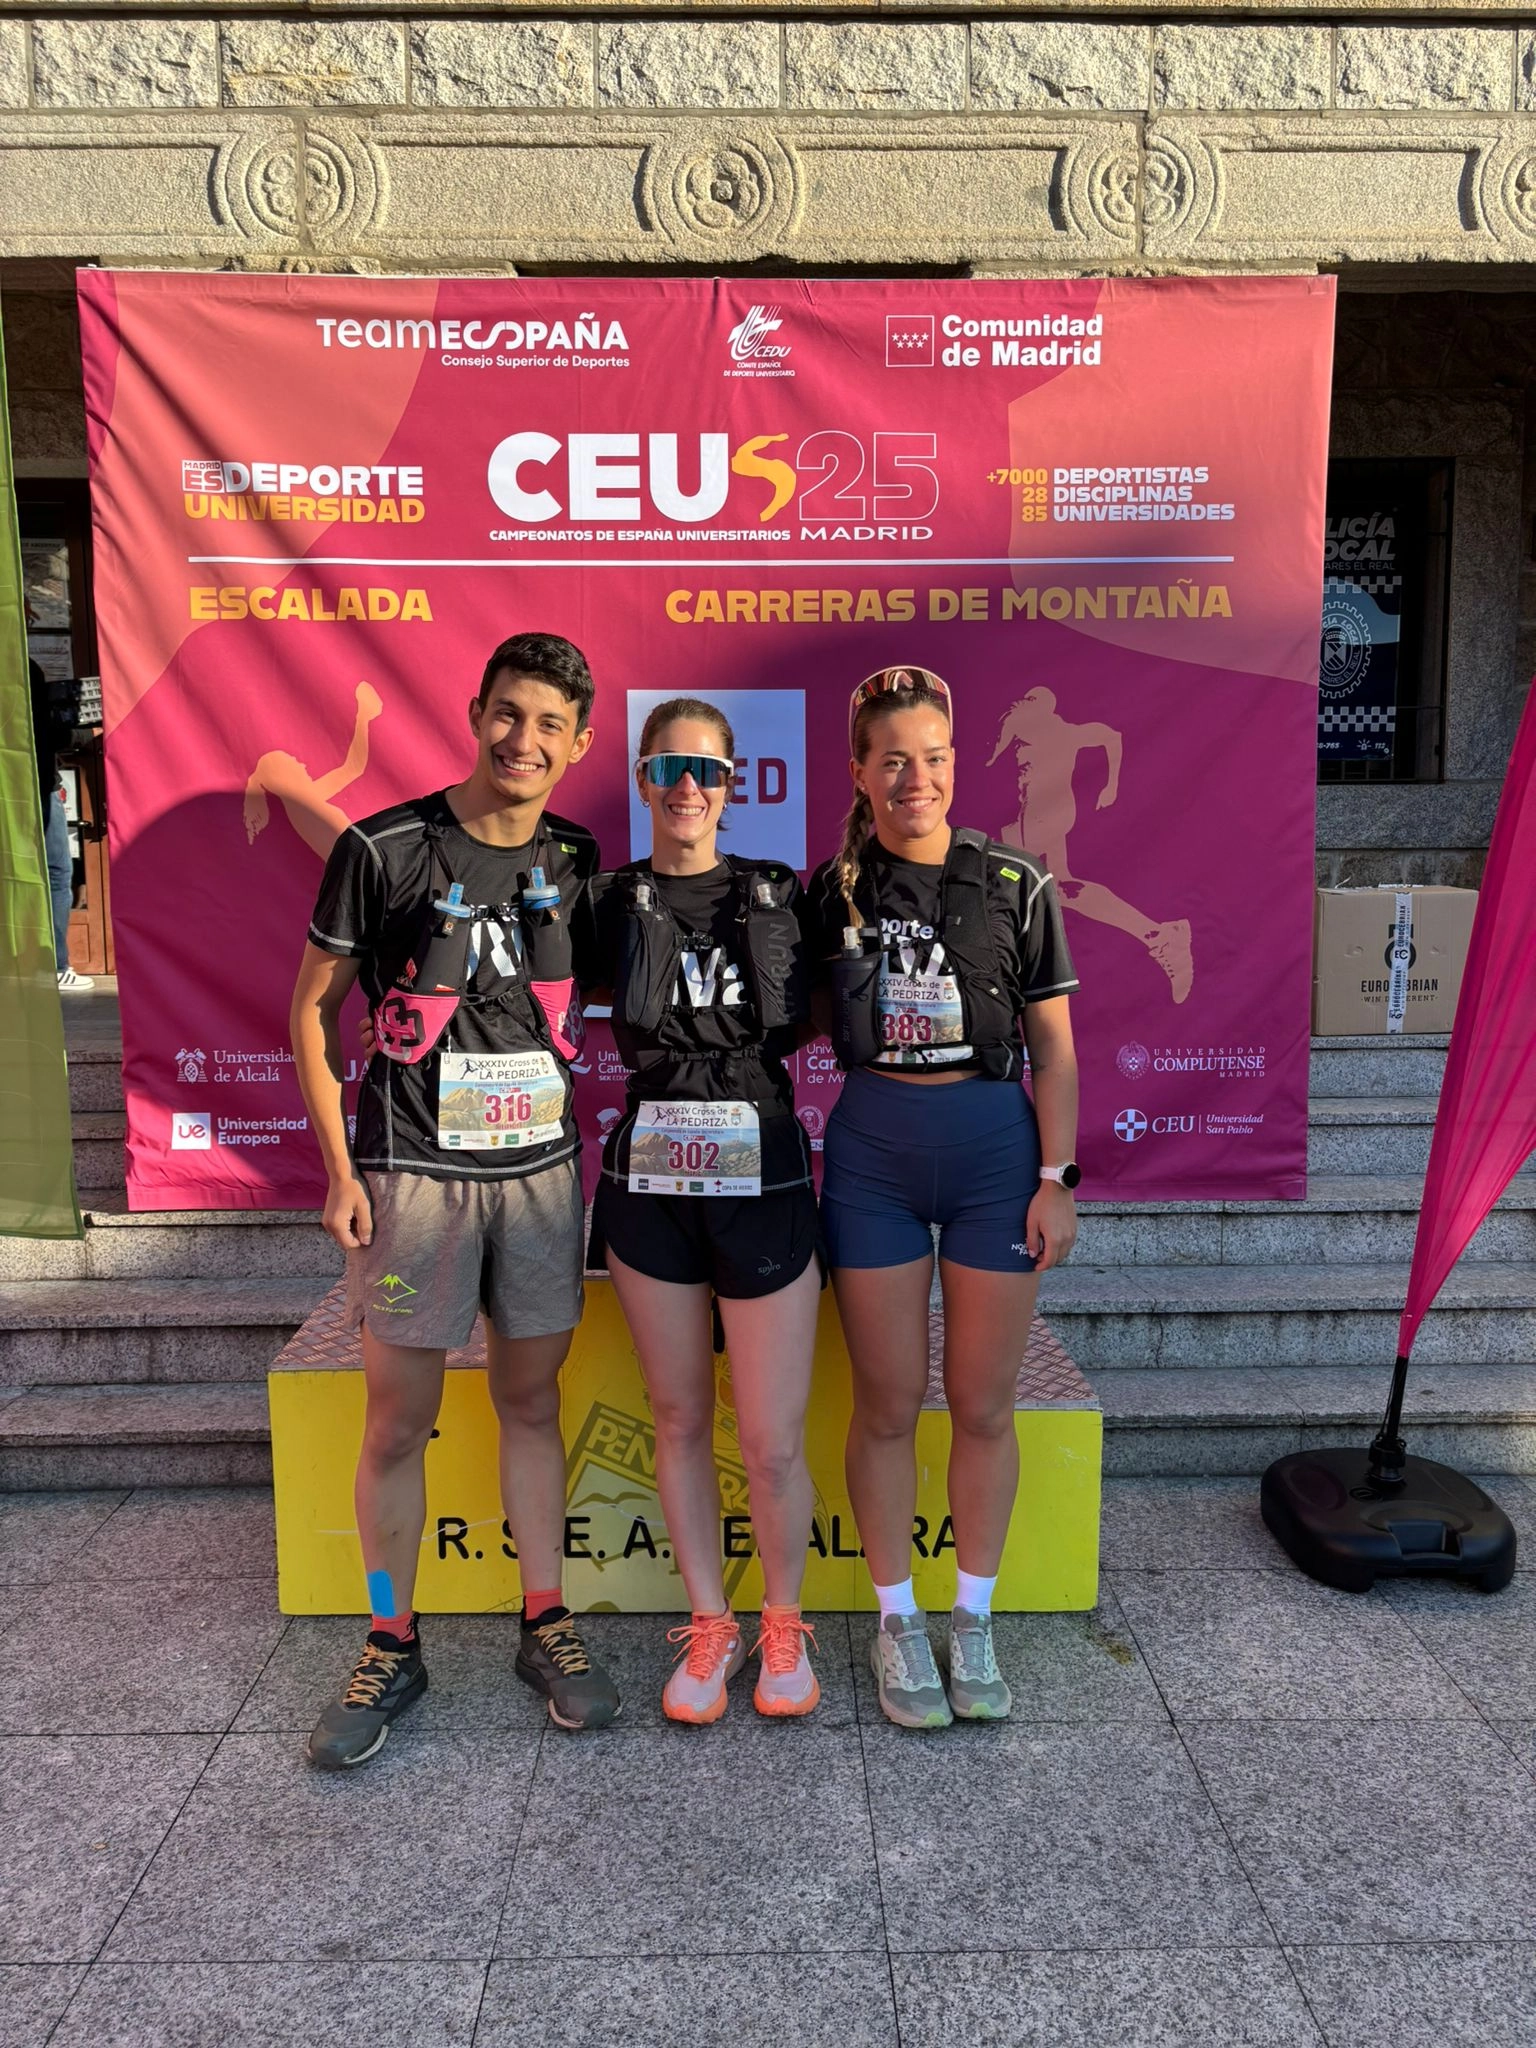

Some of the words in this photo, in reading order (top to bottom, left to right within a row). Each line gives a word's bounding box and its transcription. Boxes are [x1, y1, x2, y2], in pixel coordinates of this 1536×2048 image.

[941, 314, 1103, 337] Comunidad
[754, 346, 792, 358] CEDU
[941, 341, 979, 366] de
[991, 340, 1102, 366] Madrid
[441, 354, 493, 368] Consejo
[496, 354, 550, 369] Superior
[553, 354, 569, 367] de
[572, 355, 630, 369] Deportes
[184, 461, 222, 471] MADRID
[184, 471, 223, 492] ES
[224, 462, 424, 496] DEPORTE
[986, 467, 1048, 485] +7000
[1054, 466, 1209, 485] DEPORTISTAS
[1022, 486, 1048, 503] 28
[1054, 486, 1193, 503] DISCIPLINAS
[184, 493, 426, 523] UNIVERSIDAD
[1022, 505, 1048, 522] 85
[1054, 504, 1236, 522] UNIVERSIDADES
[489, 529, 594, 541] CAMPEONATOS
[597, 530, 615, 541] DE
[618, 528, 674, 541] ESPAÑA
[676, 530, 792, 541] UNIVERSITARIOS
[801, 526, 933, 541] MADRID
[1353, 561, 1365, 571] EL
[1368, 561, 1396, 571] REAL
[189, 586, 434, 622] ESCALADA
[665, 589, 917, 623] CARRERAS
[929, 588, 989, 621] DE
[1002, 578, 1233, 620] MONTAÑA
[929, 980, 940, 989] de
[1361, 979, 1438, 993] EUROBRIAN
[892, 990, 940, 1000] PEDRIZA
[882, 1013, 932, 1042] 383
[598, 1050, 620, 1062] Uni
[806, 1043, 834, 1055] Univ
[1154, 1046, 1266, 1056] UNIVERSIDAD
[478, 1060, 507, 1068] XXXIV
[509, 1060, 530, 1068] Cross
[1153, 1056, 1265, 1072] COMPLUTENSE
[213, 1065, 232, 1083] de
[235, 1064, 280, 1083] Alcalá
[479, 1071, 493, 1080] LA
[497, 1068, 540, 1080] PEDRIZA
[807, 1073, 824, 1084] de
[1219, 1070, 1265, 1078] MADRID
[485, 1092, 532, 1124] 316
[665, 1107, 690, 1115] XXXIV
[691, 1107, 716, 1116] Cross
[717, 1106, 728, 1115] de
[217, 1117, 307, 1131] Universidad
[666, 1117, 677, 1126] LA
[680, 1117, 728, 1127] PEDRIZA
[1152, 1115, 1195, 1134] CEU
[1206, 1114, 1264, 1124] Universidad
[1206, 1125, 1225, 1134] San
[1226, 1124, 1253, 1134] Pablo
[217, 1131, 280, 1147] Europea
[668, 1141, 720, 1171] 302
[757, 1263, 781, 1276] spyro
[436, 1515, 483, 1559] R.
[623, 1514, 670, 1559] A.
